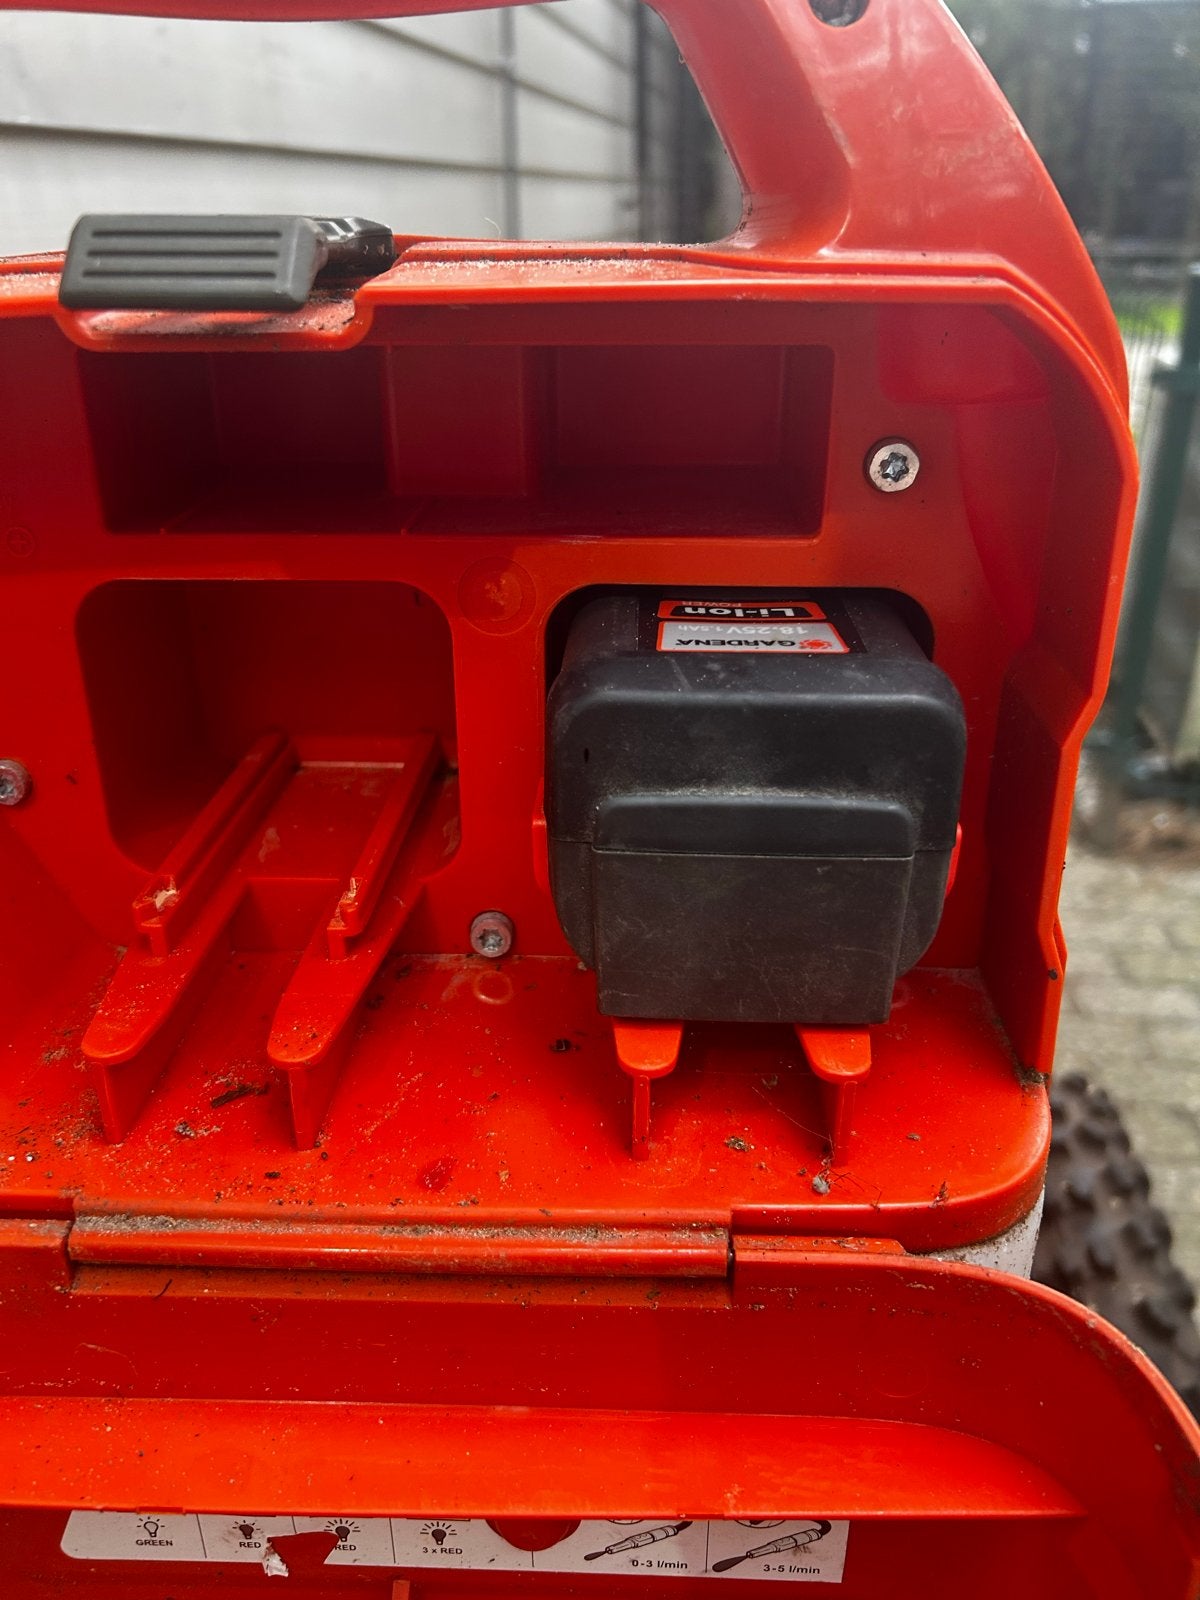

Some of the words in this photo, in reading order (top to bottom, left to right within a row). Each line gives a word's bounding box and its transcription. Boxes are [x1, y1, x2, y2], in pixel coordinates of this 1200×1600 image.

[727, 626, 809, 635] 18.25V
[136, 1539, 173, 1547] GREEN
[239, 1541, 261, 1549] RED
[422, 1547, 429, 1555] 3
[440, 1547, 463, 1555] RED
[631, 1560, 653, 1569] 0-3
[657, 1560, 689, 1570] l/min
[763, 1564, 786, 1573] 3-5
[789, 1565, 821, 1575] l/min
